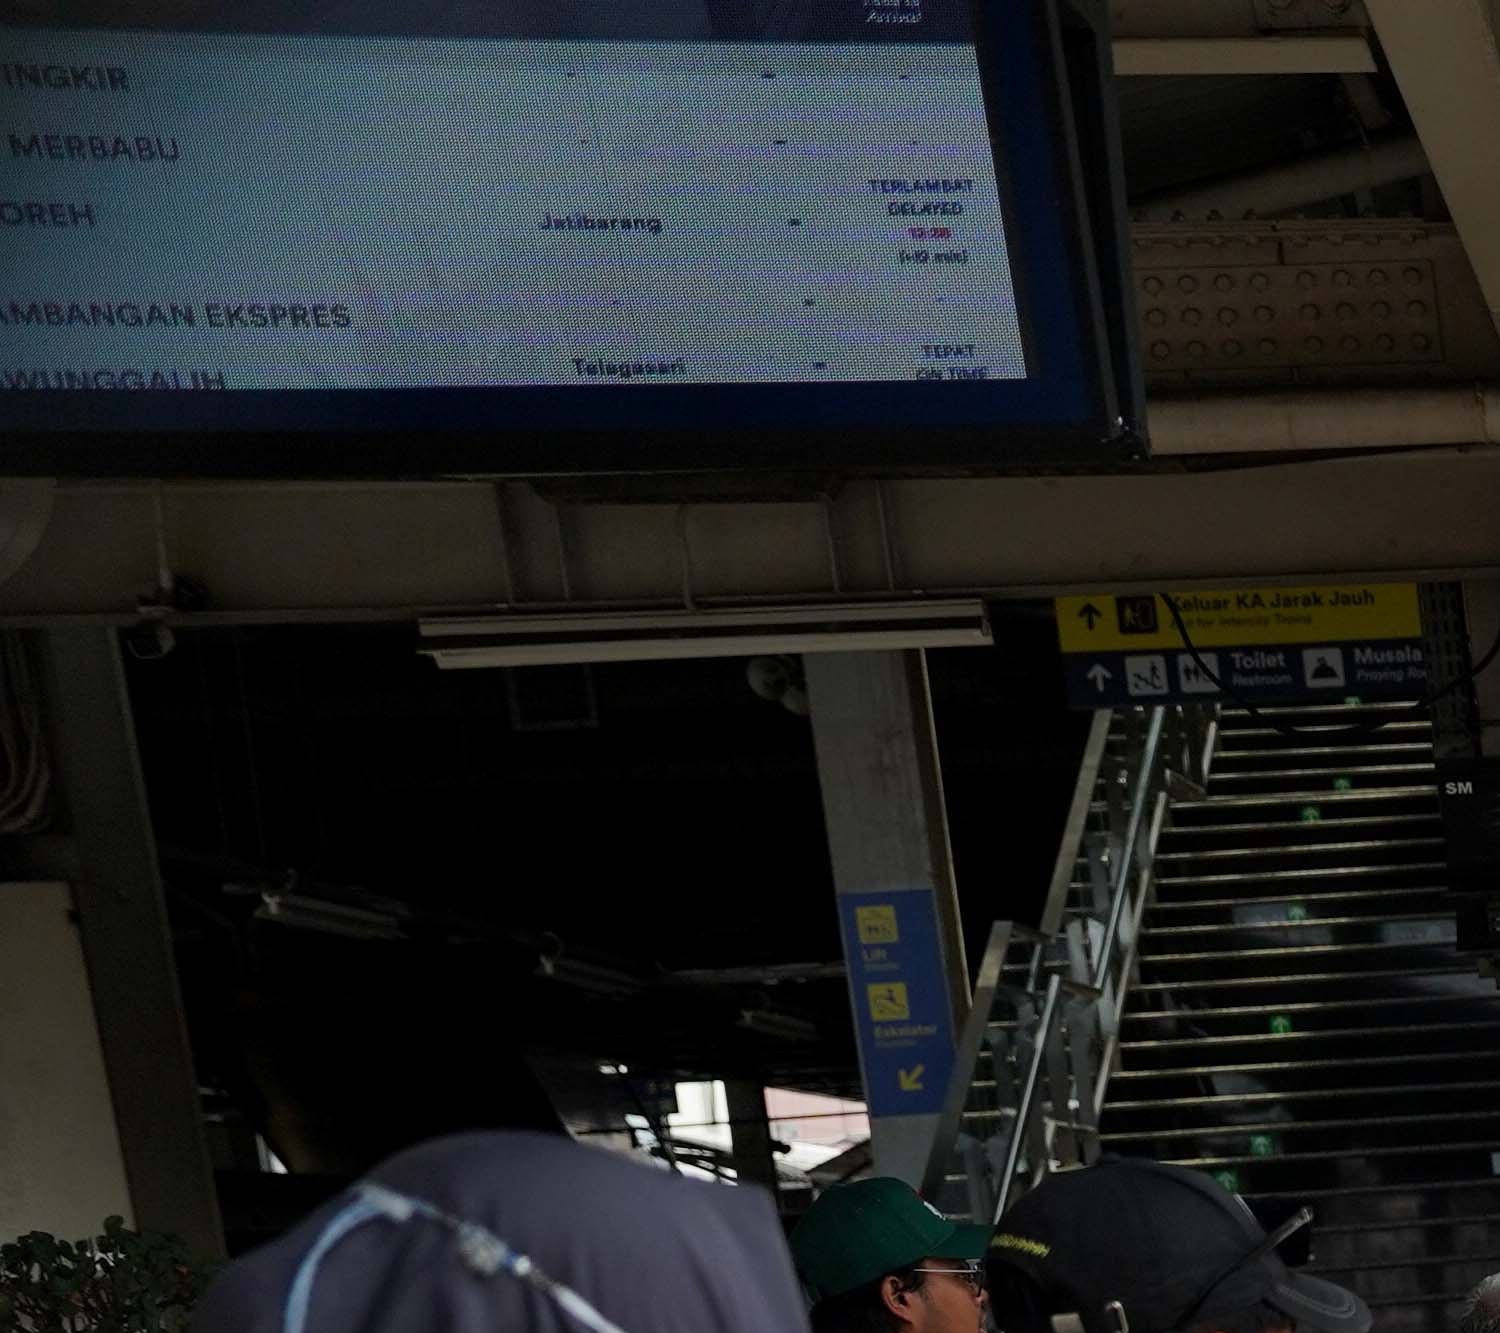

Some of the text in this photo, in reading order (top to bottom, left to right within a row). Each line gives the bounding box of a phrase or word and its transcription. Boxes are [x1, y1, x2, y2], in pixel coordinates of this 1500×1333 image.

[9, 134, 179, 161] MERBABU
[540, 213, 662, 234] Jatibarang
[208, 303, 352, 328] EKSPRES
[573, 357, 685, 378] Telagasari
[1236, 593, 1265, 609] KA
[1270, 591, 1323, 608] Jarak
[1329, 589, 1375, 606] Jauh
[1230, 651, 1286, 669] Toilet
[1354, 645, 1422, 664] Musala
[1357, 667, 1404, 683] Praying
[1445, 782, 1473, 795] SM
